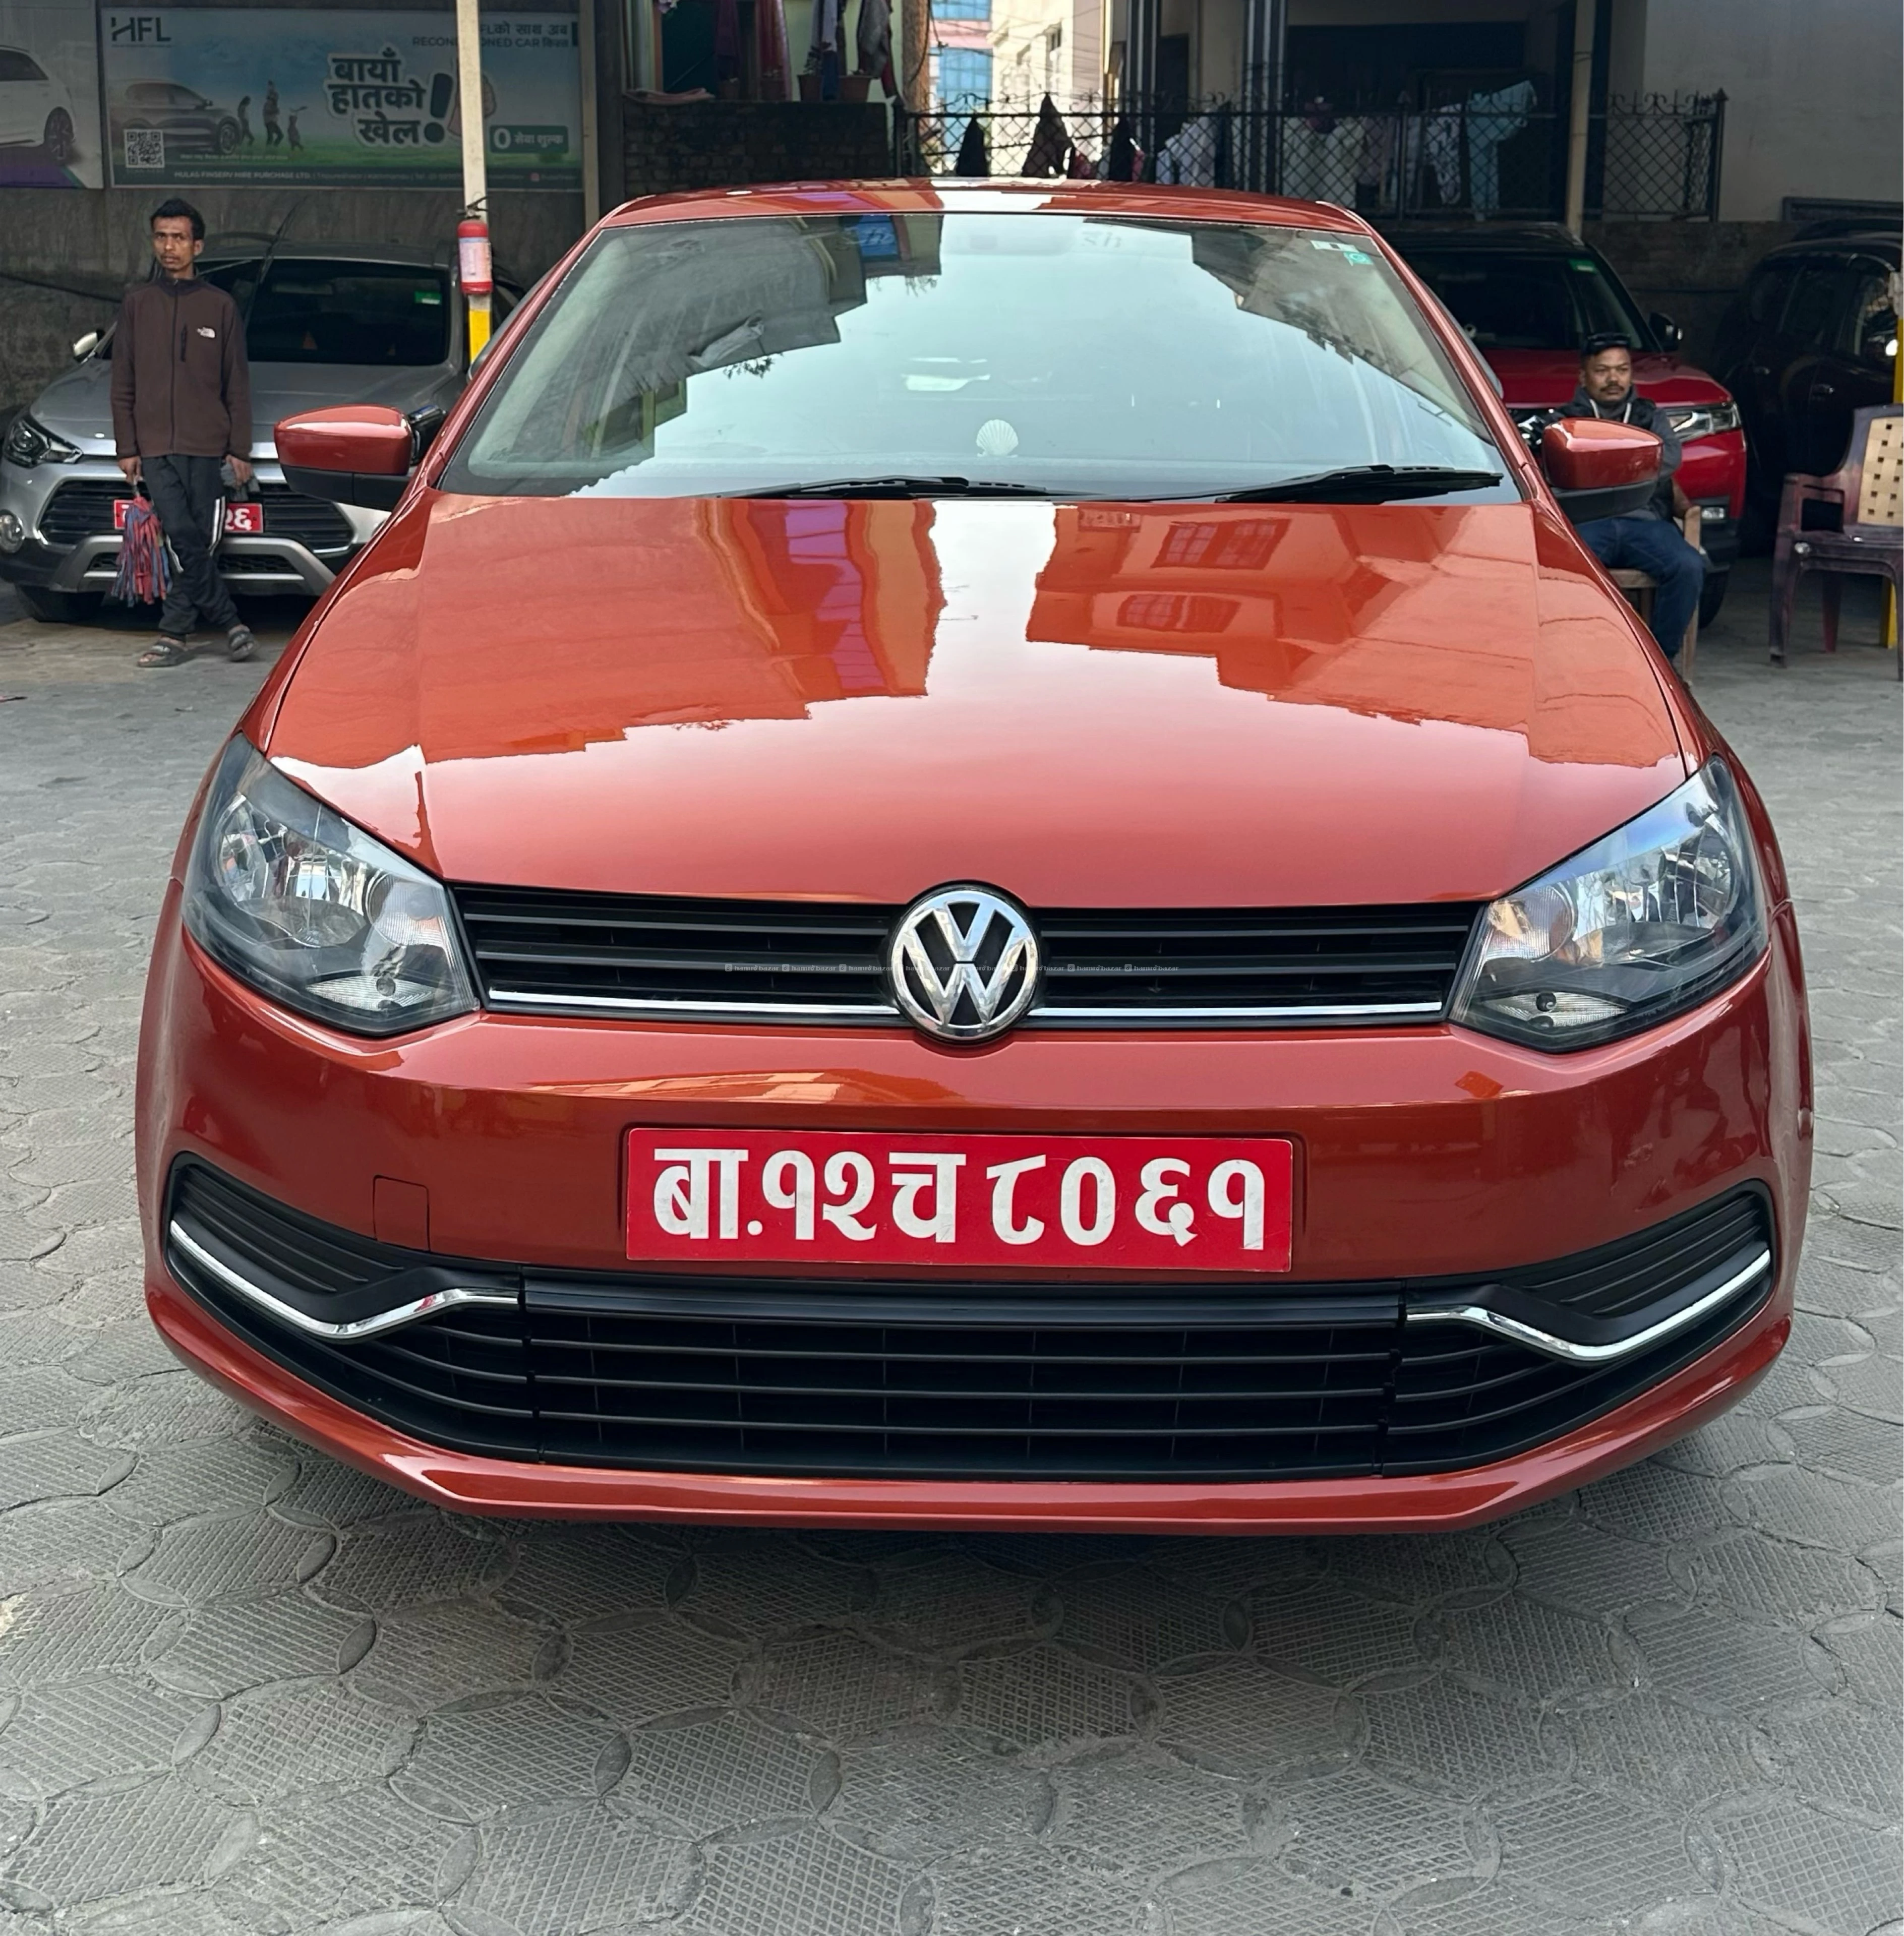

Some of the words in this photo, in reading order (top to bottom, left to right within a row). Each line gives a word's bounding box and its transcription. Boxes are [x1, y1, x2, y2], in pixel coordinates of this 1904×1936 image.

[111, 17, 172, 41] HFL
[515, 38, 540, 47] CAR
[328, 78, 426, 114] हातको
